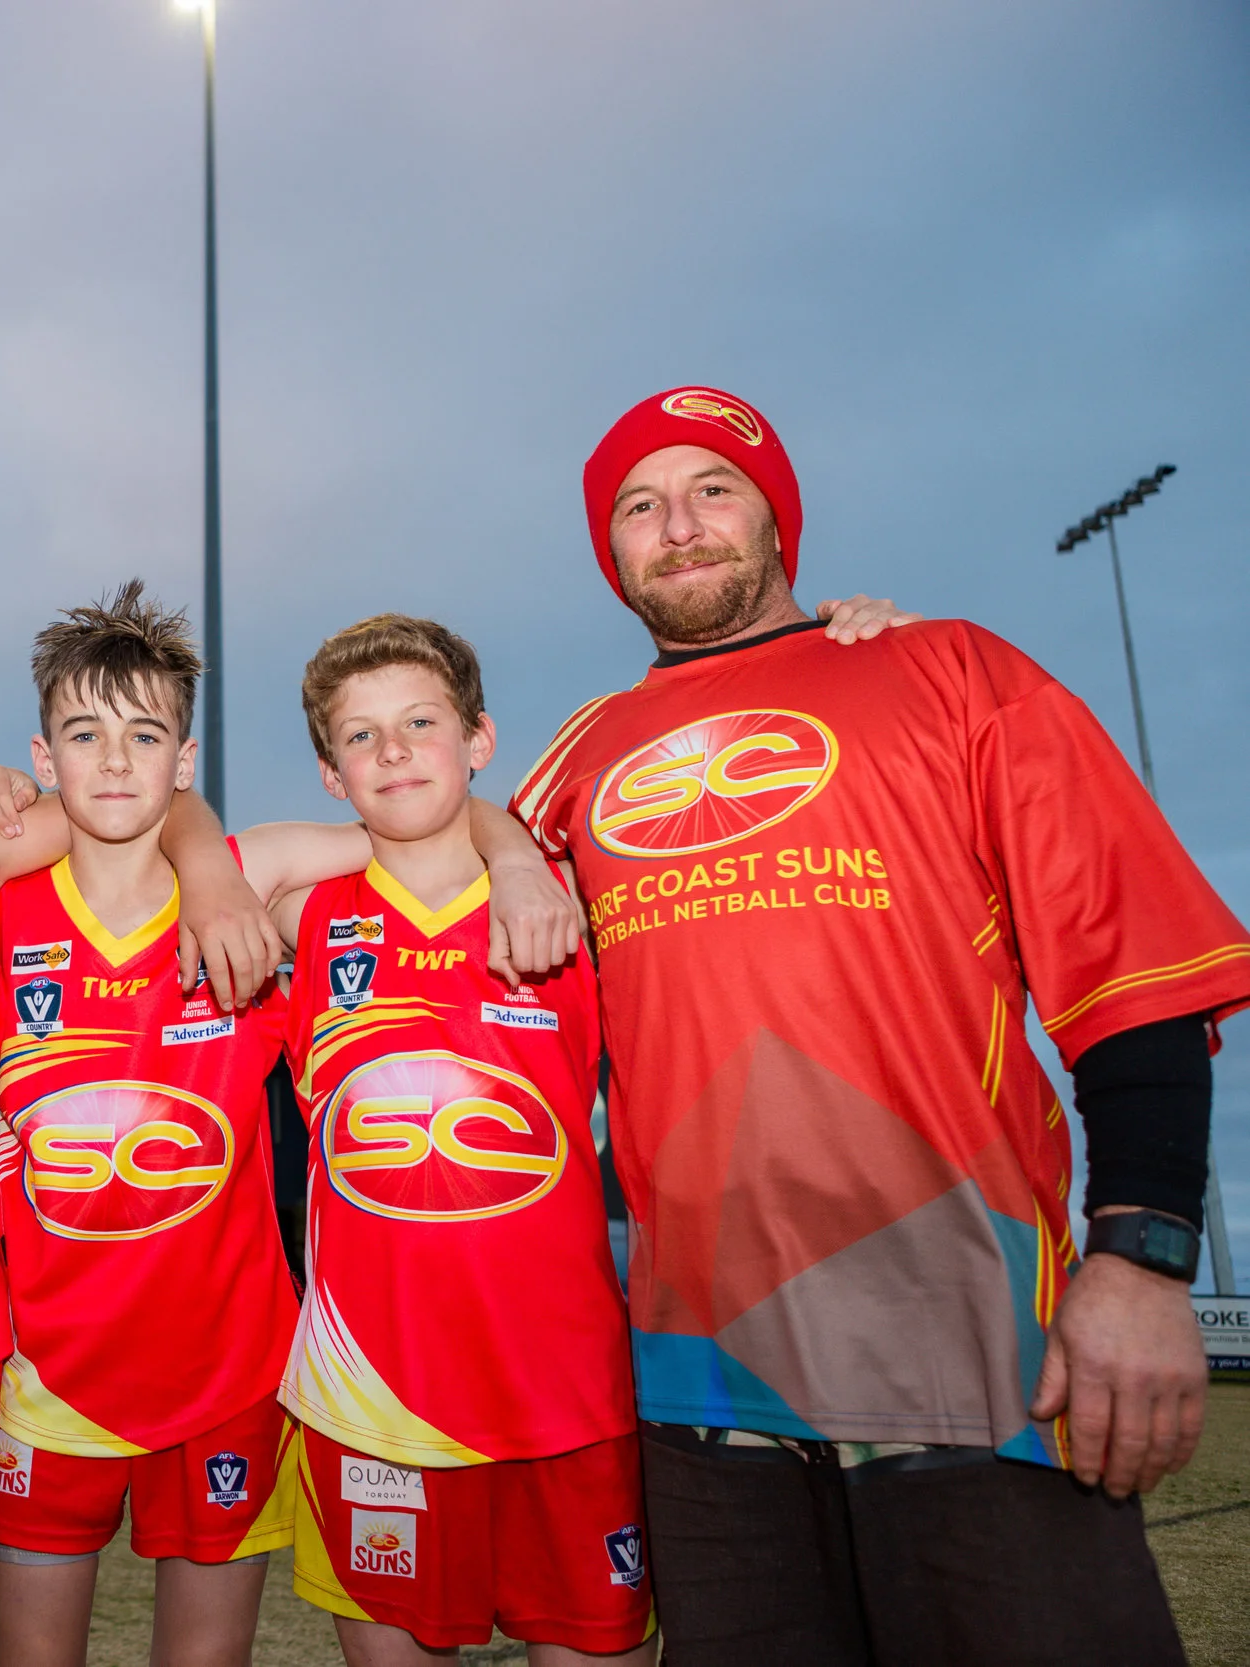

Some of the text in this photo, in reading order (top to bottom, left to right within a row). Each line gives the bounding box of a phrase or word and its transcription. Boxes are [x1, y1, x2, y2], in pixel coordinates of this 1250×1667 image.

[597, 733, 824, 834] SC
[636, 852, 763, 903] COAST
[775, 847, 888, 878] SUNS
[597, 884, 891, 954] OTBALL NETBALL CLUB
[345, 950, 361, 959] AFL
[396, 947, 467, 971] TWP
[32, 979, 48, 988] AFL
[82, 976, 150, 999] TWP
[186, 999, 208, 1011] JUNIOR
[336, 994, 364, 1005] COUNTRY
[504, 993, 540, 1004] FOOTBALL
[181, 1008, 212, 1019] FOOTBALL
[494, 1010, 557, 1027] Advertiser
[26, 1023, 53, 1032] COUNTRY
[172, 1022, 232, 1041] Advertiser
[330, 1095, 558, 1175] SC
[29, 1121, 227, 1192] SC
[215, 1493, 240, 1501] BARWON
[365, 1491, 407, 1499] TORQUAY
[354, 1545, 412, 1576] SUNS
